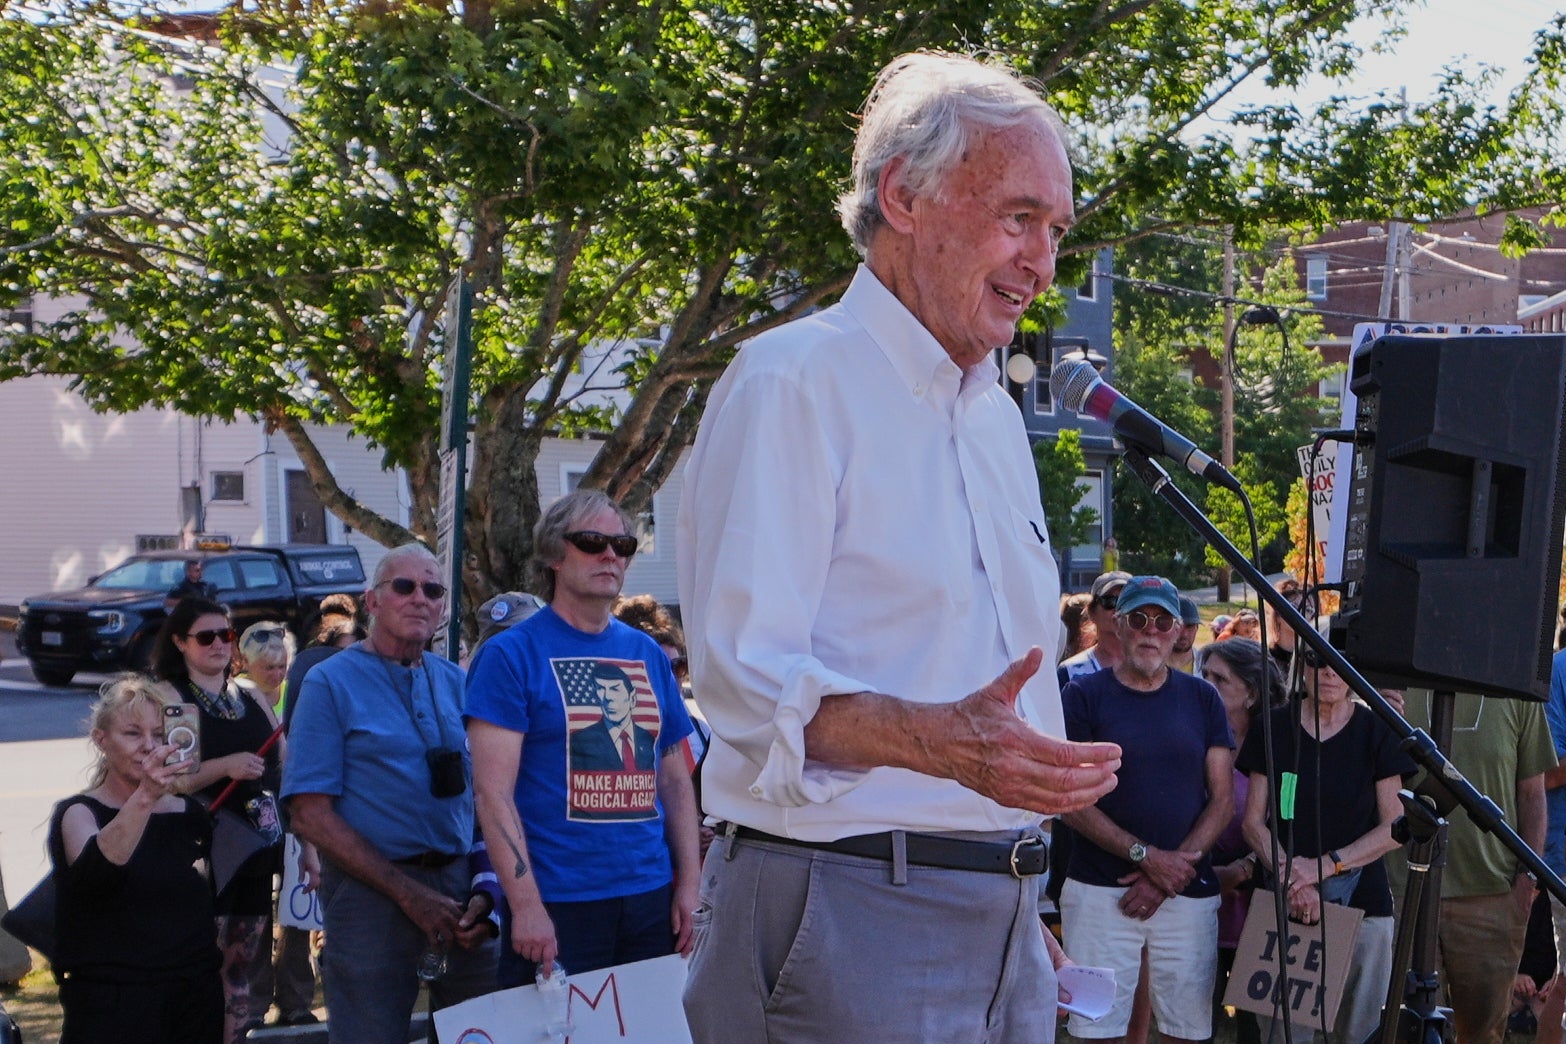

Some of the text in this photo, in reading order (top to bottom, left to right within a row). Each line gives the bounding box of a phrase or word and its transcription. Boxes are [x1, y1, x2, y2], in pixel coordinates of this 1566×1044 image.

[573, 774, 611, 791] MAKE
[573, 792, 628, 808] LOGICAL
[1259, 930, 1323, 972] ICE
